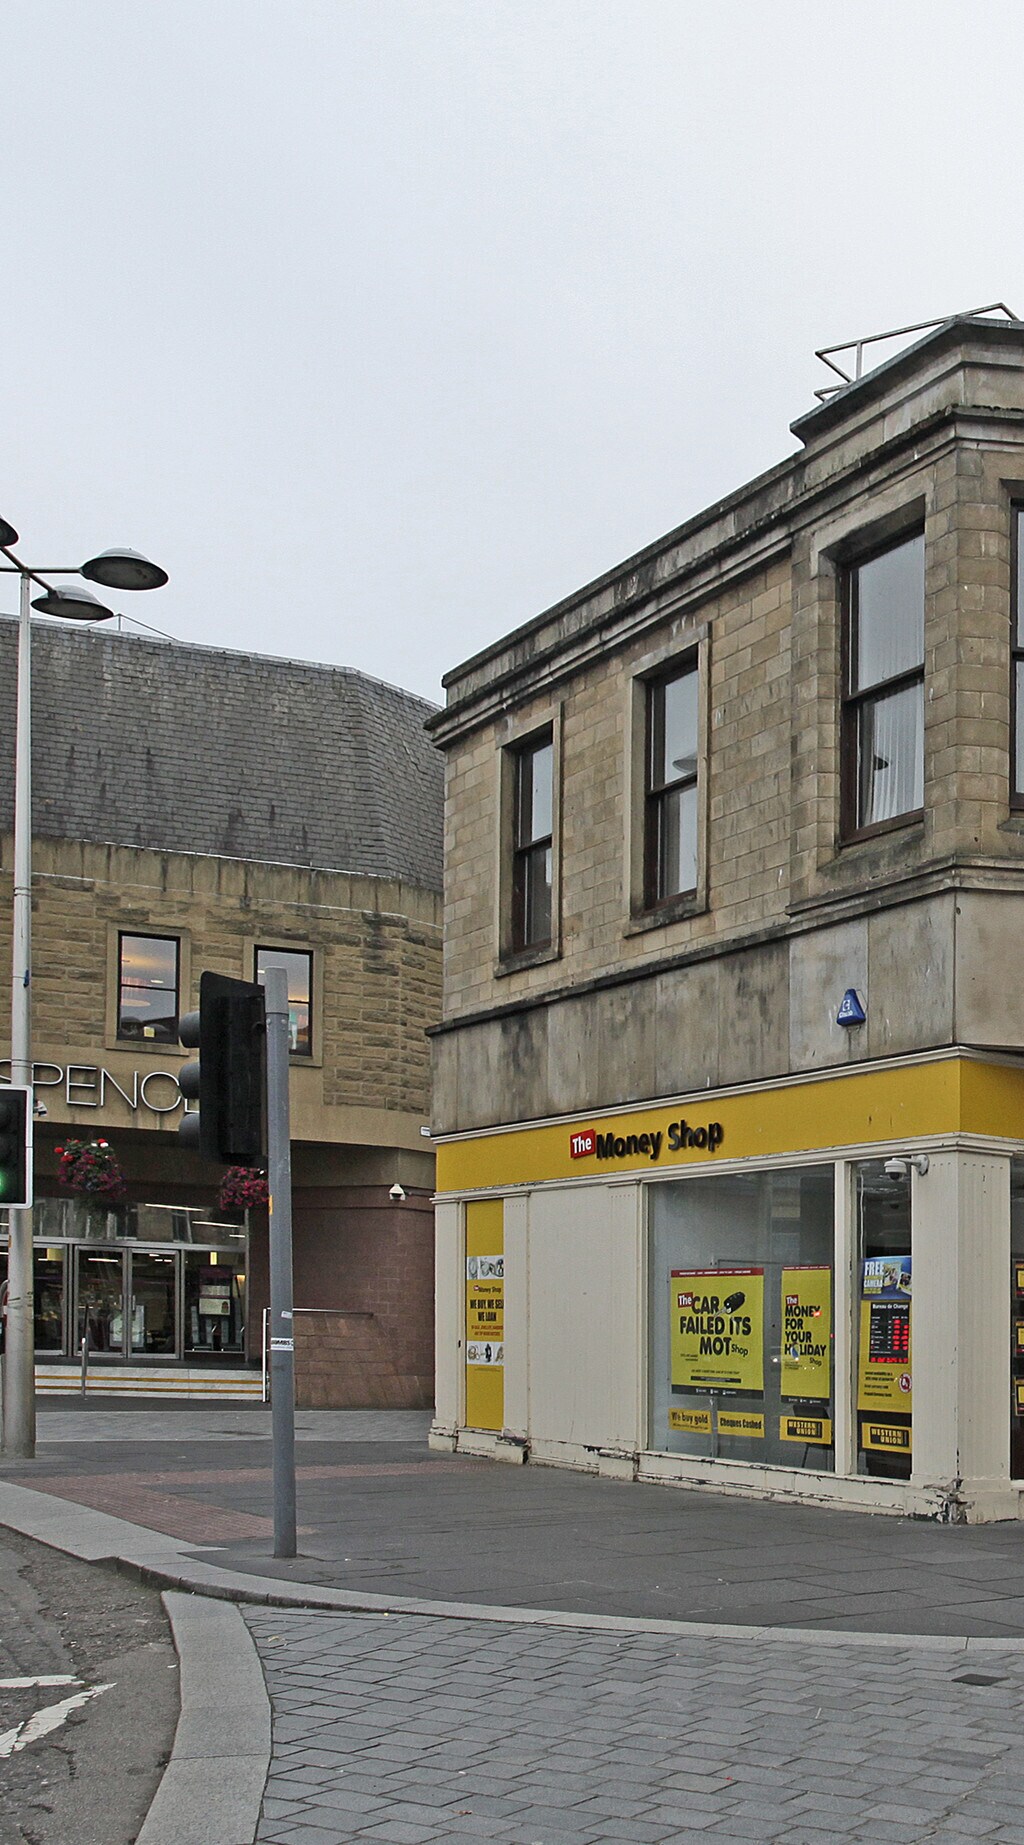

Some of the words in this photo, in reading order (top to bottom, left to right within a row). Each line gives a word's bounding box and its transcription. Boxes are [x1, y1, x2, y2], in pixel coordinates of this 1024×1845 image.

[0, 1060, 199, 1112] PENC
[572, 1136, 592, 1154] The
[596, 1131, 662, 1160] Money
[668, 1119, 723, 1152] Shop
[864, 1261, 884, 1276] FREE
[470, 1299, 477, 1309] WE
[679, 1295, 692, 1306] The
[692, 1296, 720, 1314] CAR
[786, 1296, 798, 1305] The
[785, 1305, 821, 1317] MONEY
[680, 1316, 725, 1335] FAILED
[729, 1316, 752, 1336] ITS
[785, 1318, 804, 1330] FOR
[784, 1331, 812, 1343] YOUR
[699, 1336, 732, 1356] MOT
[731, 1344, 749, 1357] Shop
[681, 1412, 693, 1424] buy
[694, 1413, 708, 1425] gold
[720, 1418, 742, 1427] Cheques
[742, 1419, 762, 1430] Cashed
[788, 1420, 816, 1428] WESTERN
[796, 1428, 816, 1436] UNION
[871, 1428, 902, 1438] WESTERN
[880, 1436, 903, 1444] UNION
